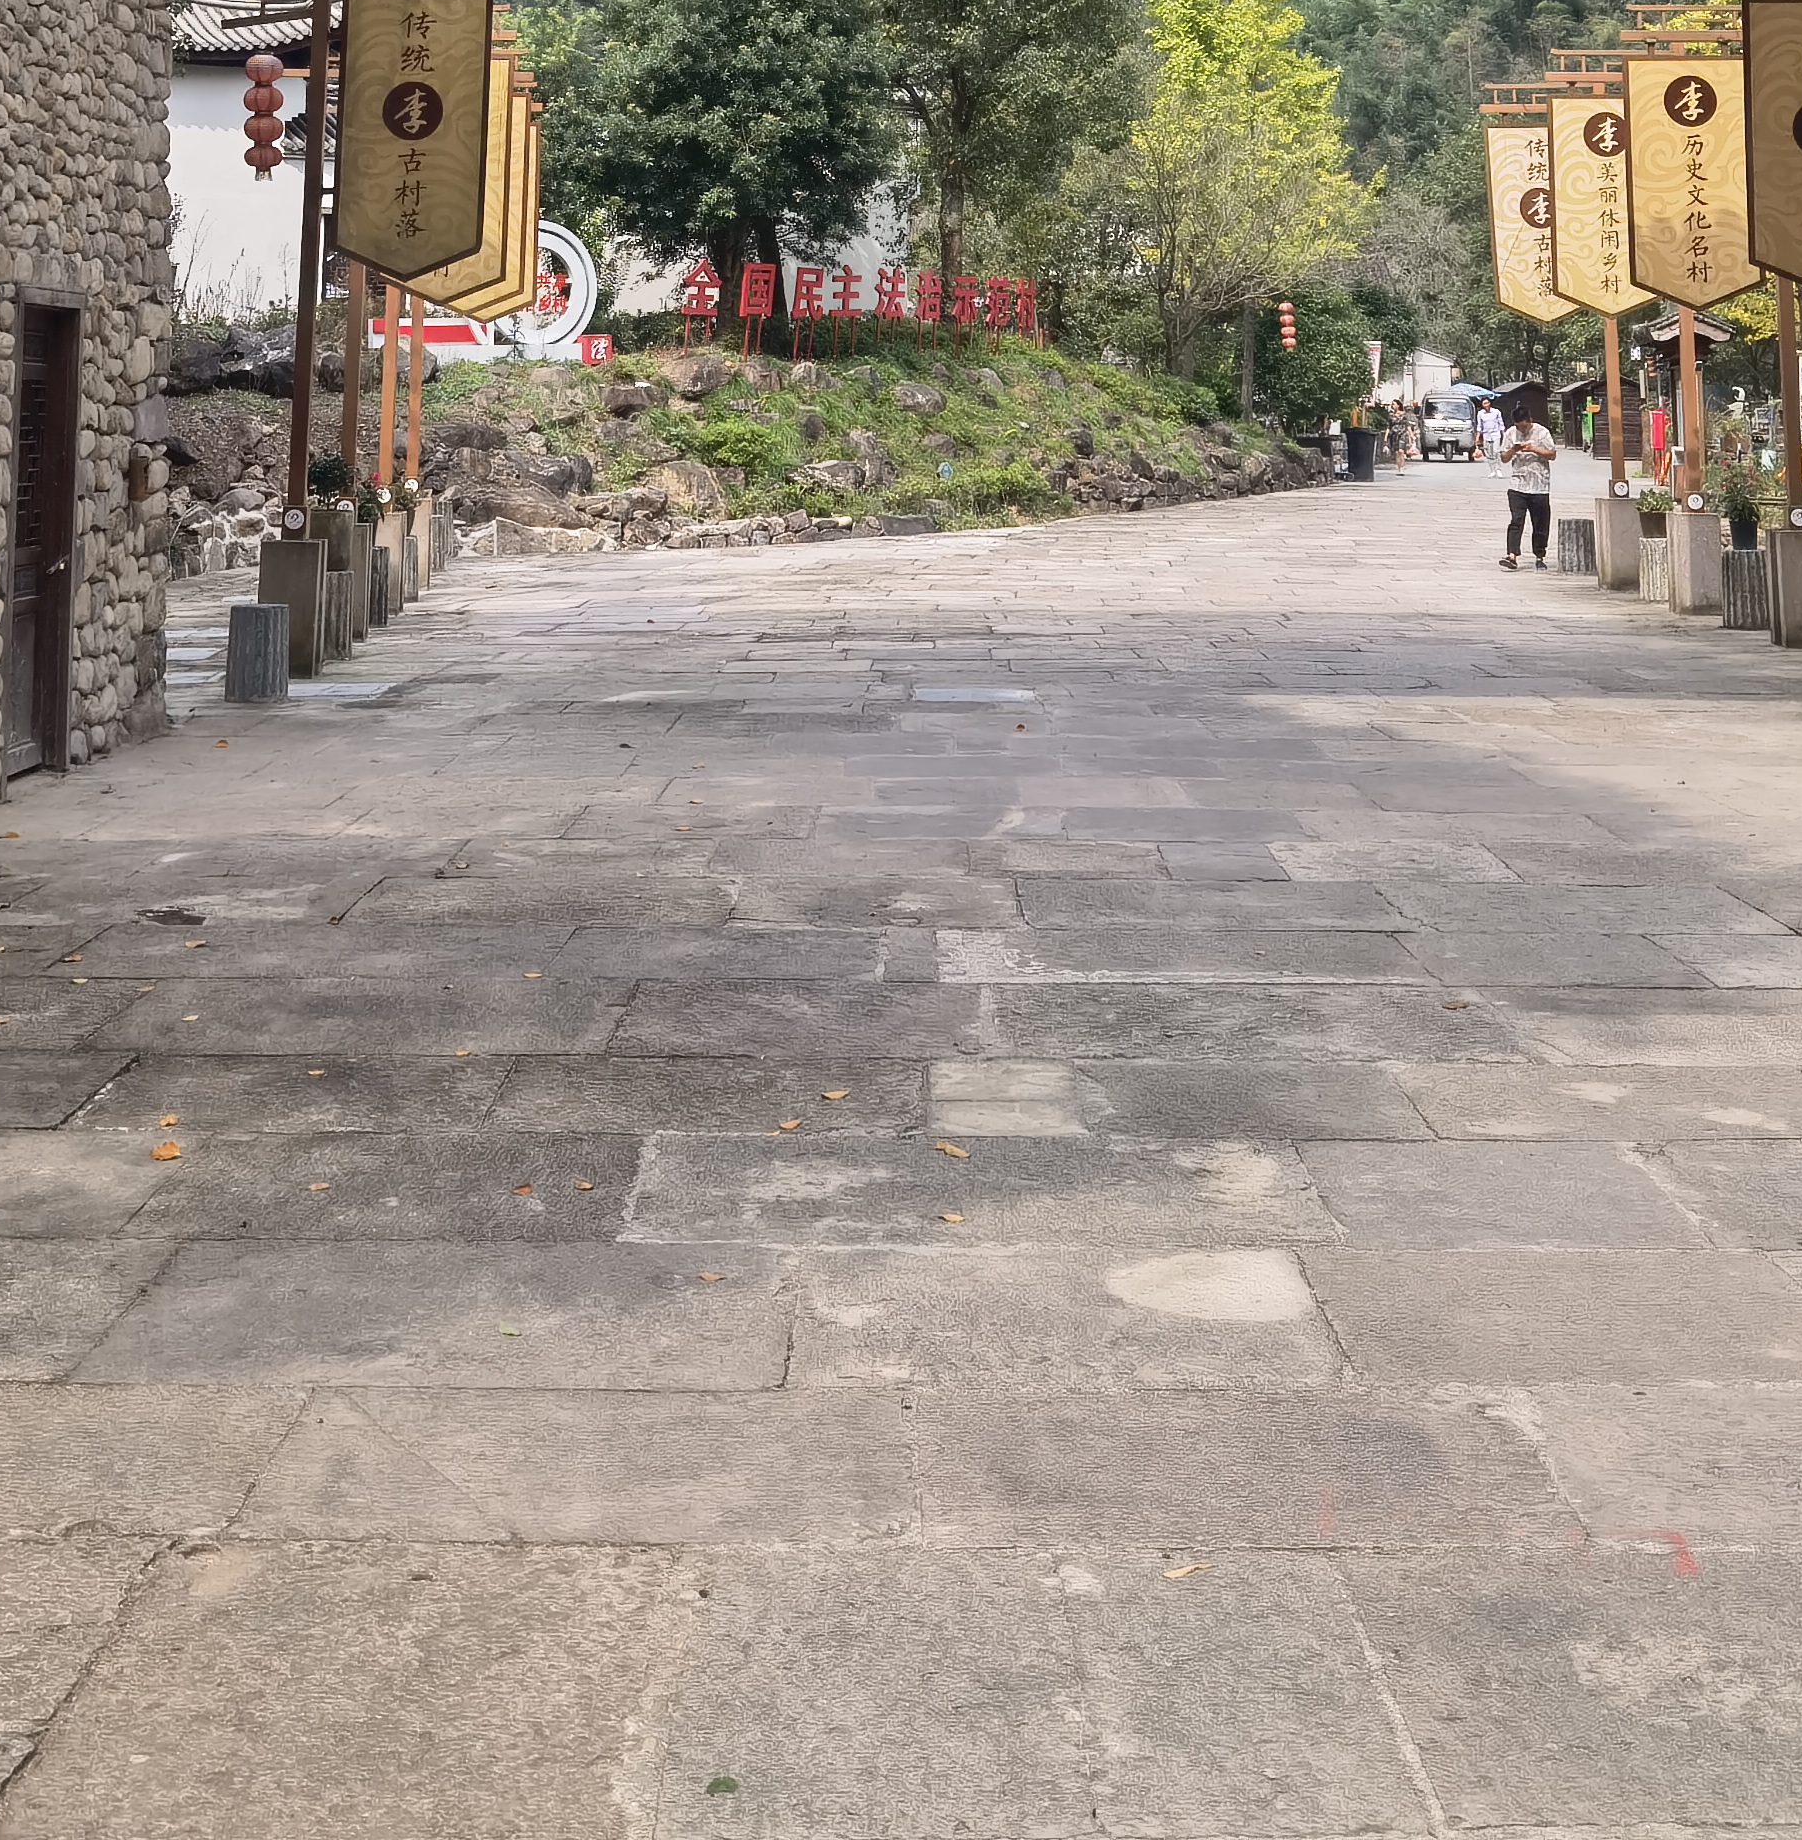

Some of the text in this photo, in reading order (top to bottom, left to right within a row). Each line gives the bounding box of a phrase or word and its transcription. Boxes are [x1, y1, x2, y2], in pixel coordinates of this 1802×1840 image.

[1596, 162, 1622, 295] 美丽休闲乡村
[1681, 134, 1714, 284] 历史文化名村
[681, 258, 1037, 329] 全国民主法治示范村
